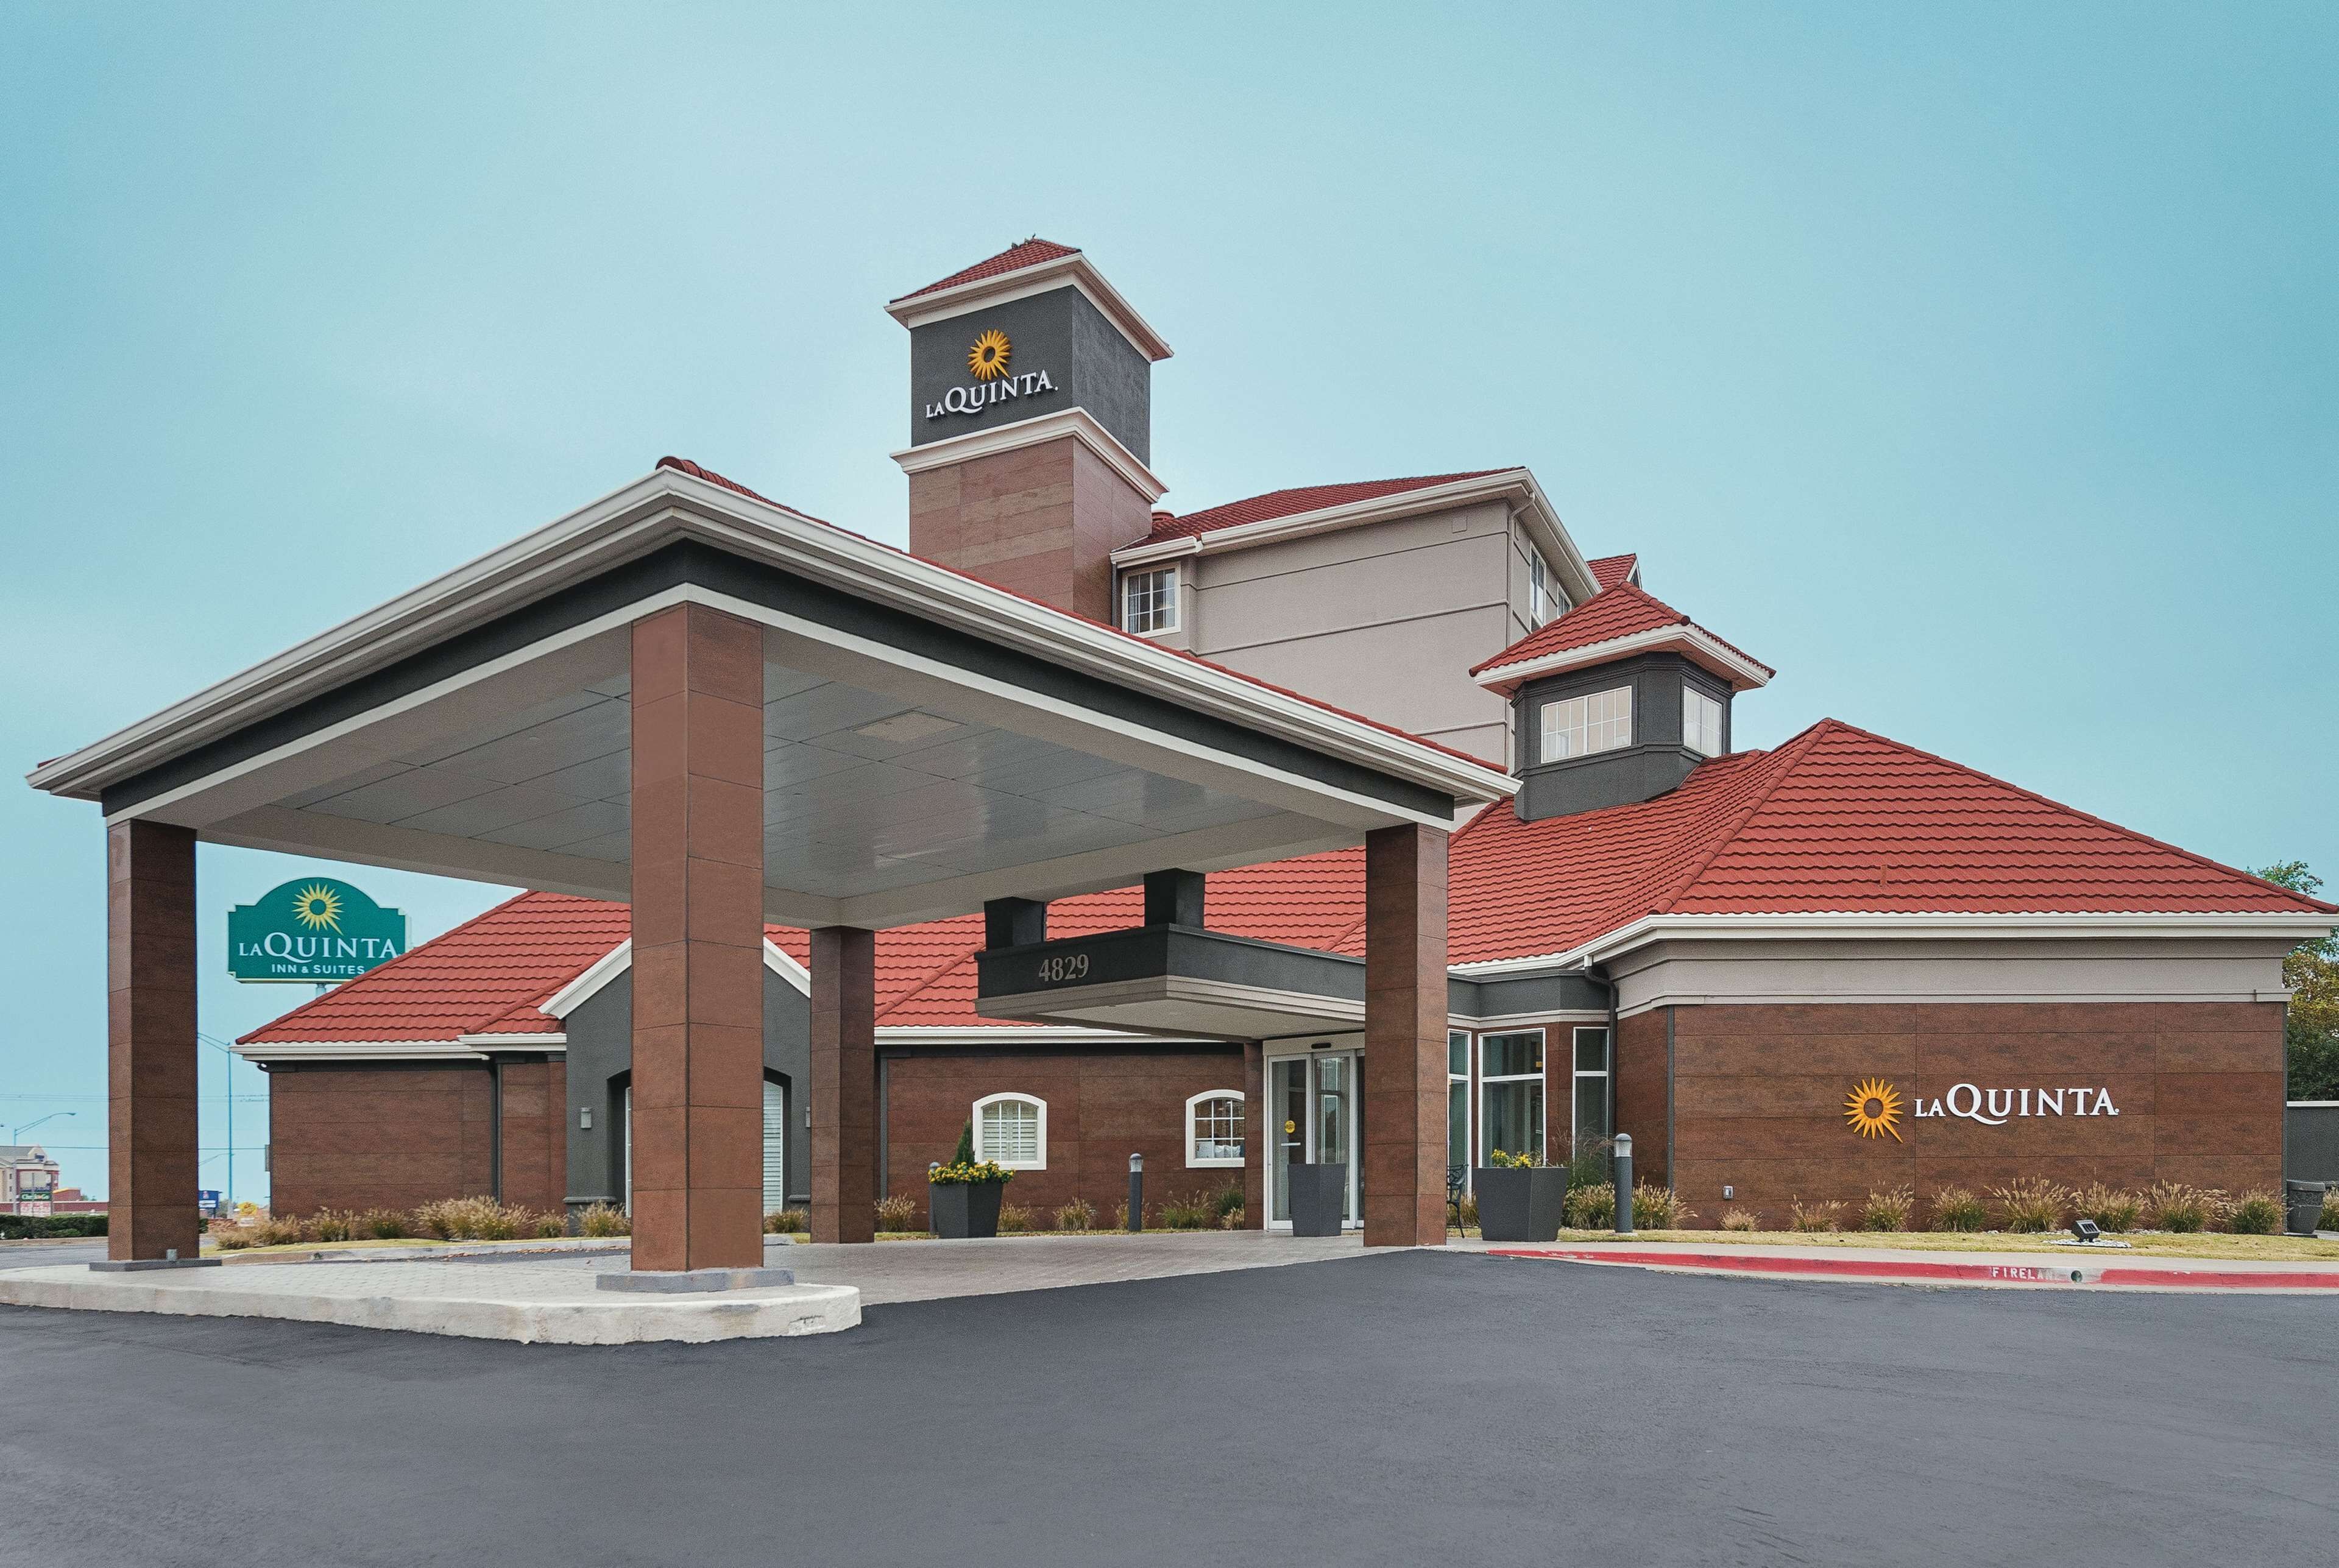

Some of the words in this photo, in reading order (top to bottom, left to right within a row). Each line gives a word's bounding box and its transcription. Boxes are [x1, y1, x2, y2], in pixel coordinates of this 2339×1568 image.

[925, 401, 944, 418] LA
[945, 369, 1053, 414] QUINTA
[239, 943, 263, 956] LA
[264, 932, 398, 963] QUINTA
[272, 964, 297, 973] INN
[313, 965, 365, 975] SUITES
[1038, 954, 1089, 982] 4829
[1914, 1098, 1945, 1117] LA
[1946, 1083, 2119, 1125] QUINTA
